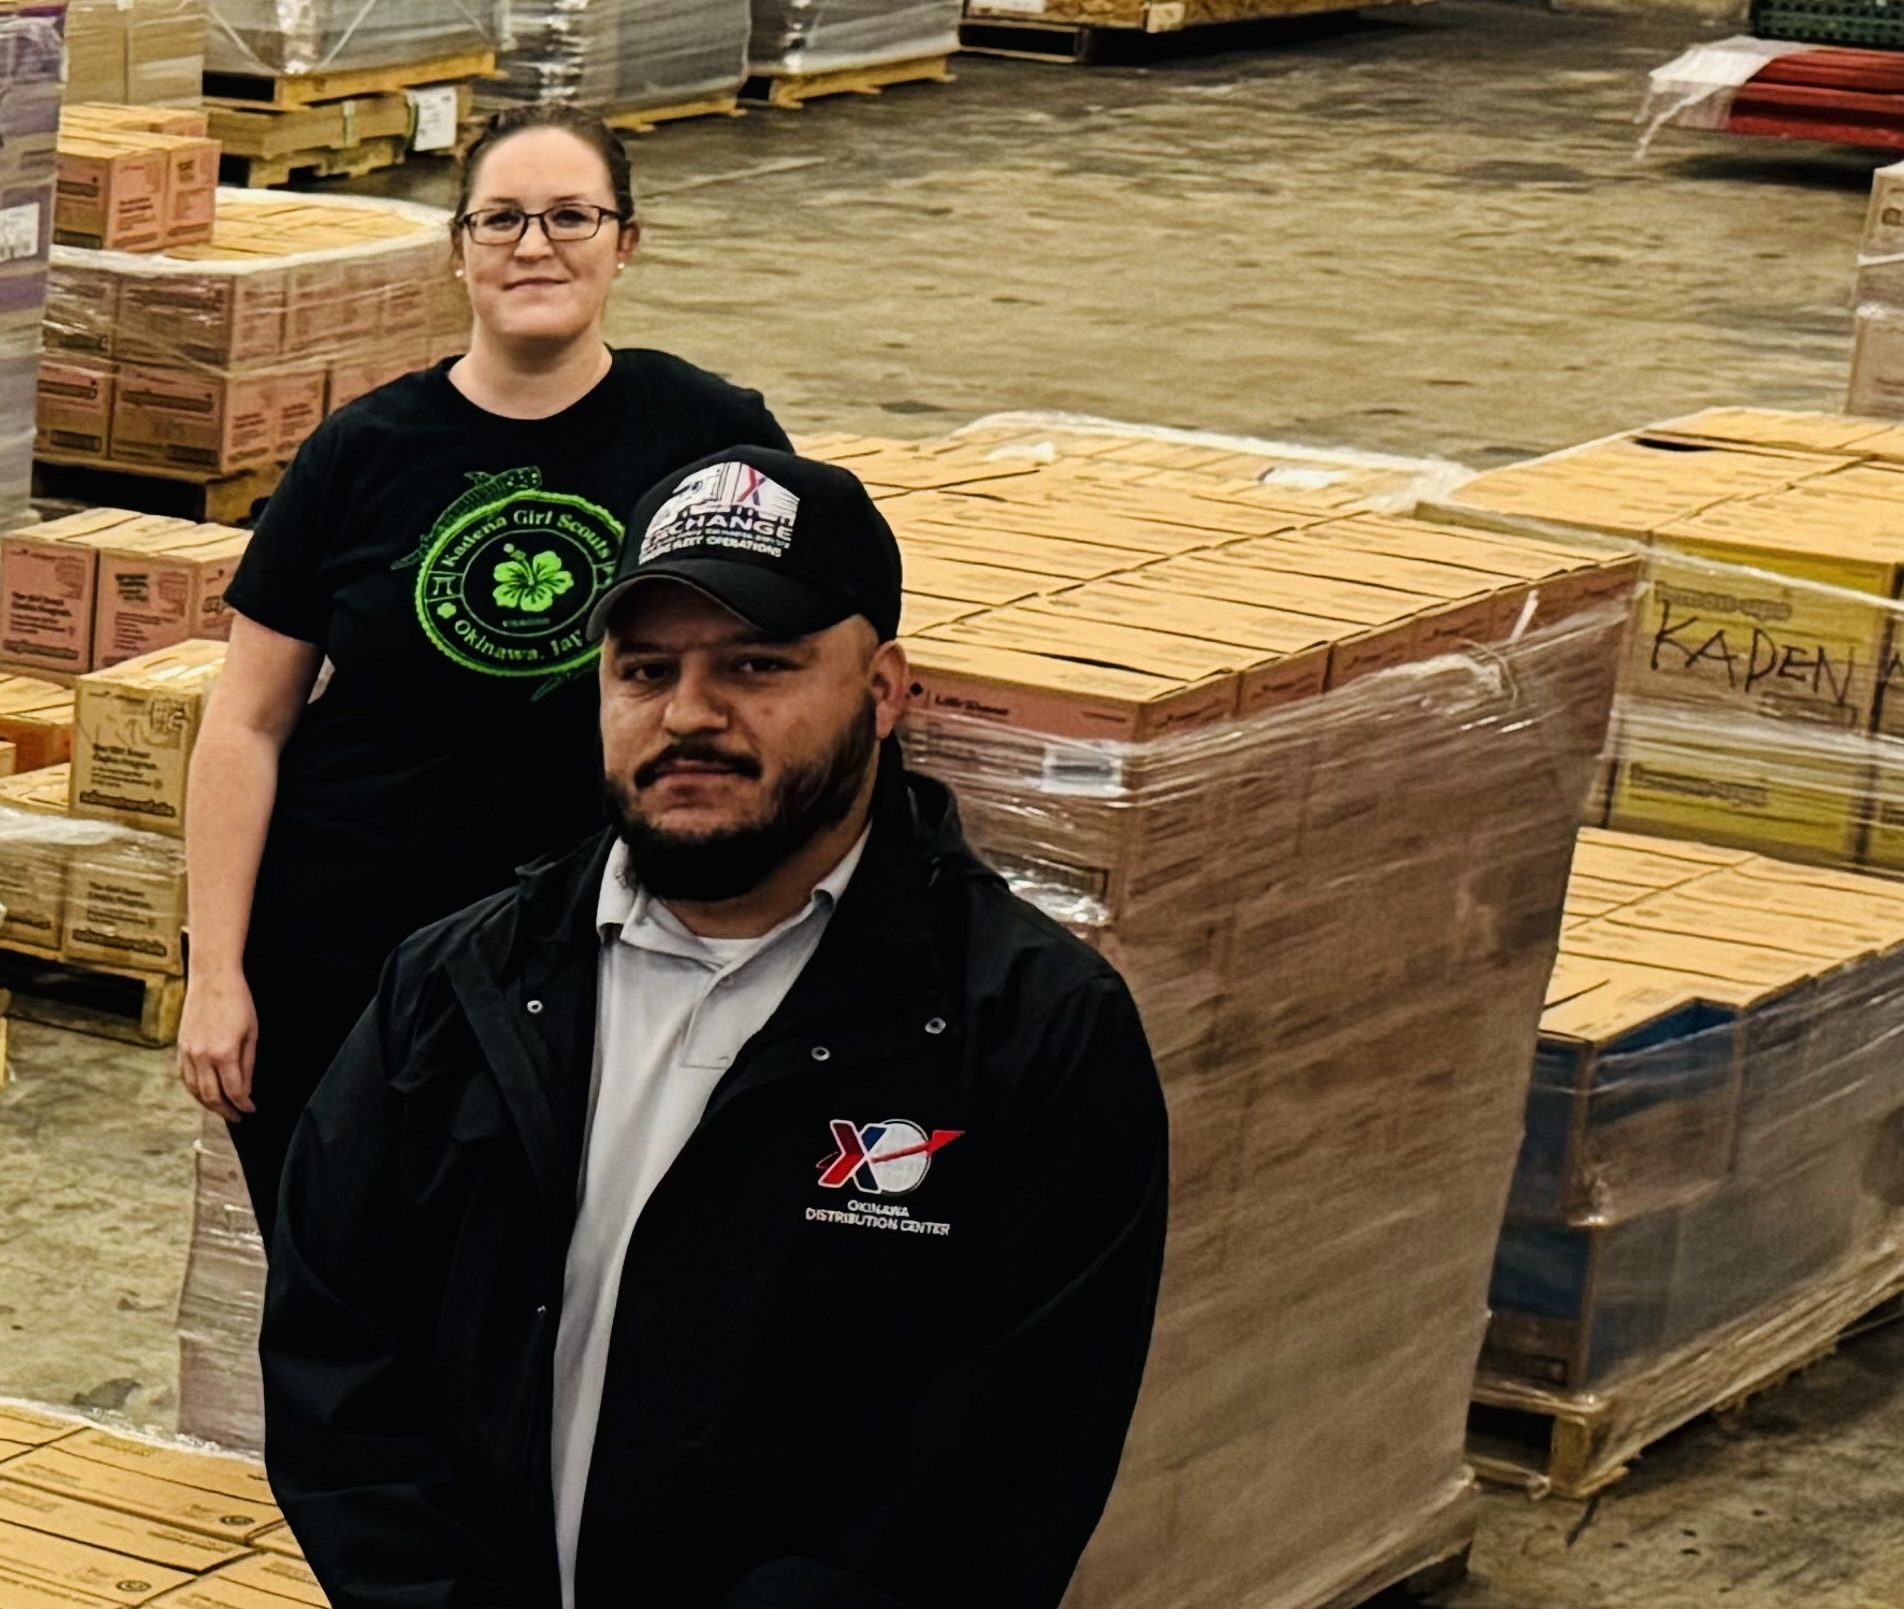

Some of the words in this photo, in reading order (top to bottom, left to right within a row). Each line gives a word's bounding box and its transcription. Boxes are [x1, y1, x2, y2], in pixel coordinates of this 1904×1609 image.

[440, 514, 507, 567] Kadena
[513, 510, 553, 526] Girl
[556, 513, 610, 561] Scouts
[705, 536, 782, 558] OPERATIONS
[550, 629, 584, 658] Jap
[1651, 599, 1856, 707] KADEN
[806, 1208, 898, 1230] DISTRIBUTION
[901, 1220, 950, 1235] CENTER
[848, 1200, 910, 1217] OKINAWA
